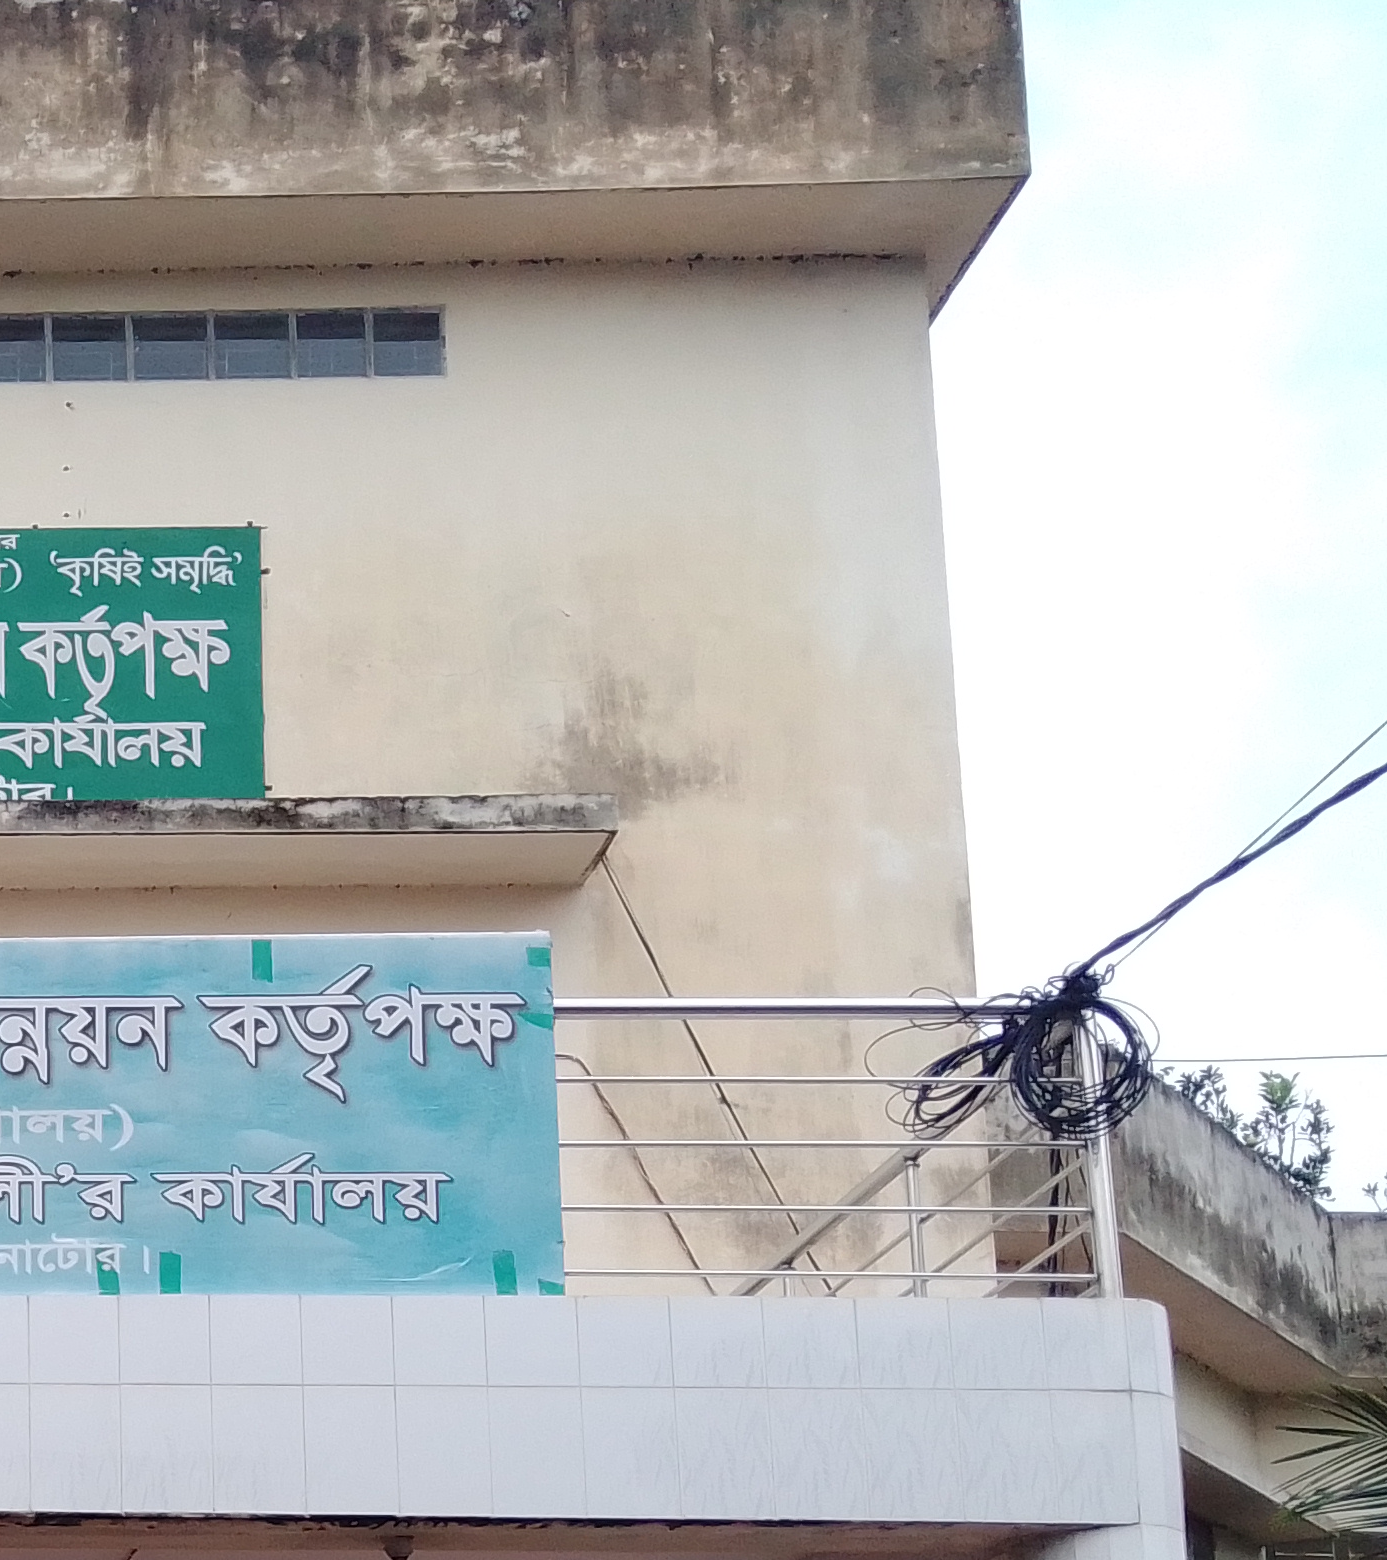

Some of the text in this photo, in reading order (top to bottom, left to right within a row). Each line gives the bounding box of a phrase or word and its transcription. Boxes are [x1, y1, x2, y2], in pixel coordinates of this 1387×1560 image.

[16, 604, 232, 721] কর্তৃপক্ষ
[196, 964, 528, 1102] কর্তৃপক্ষ
[150, 1152, 454, 1225] কার্যালয়
